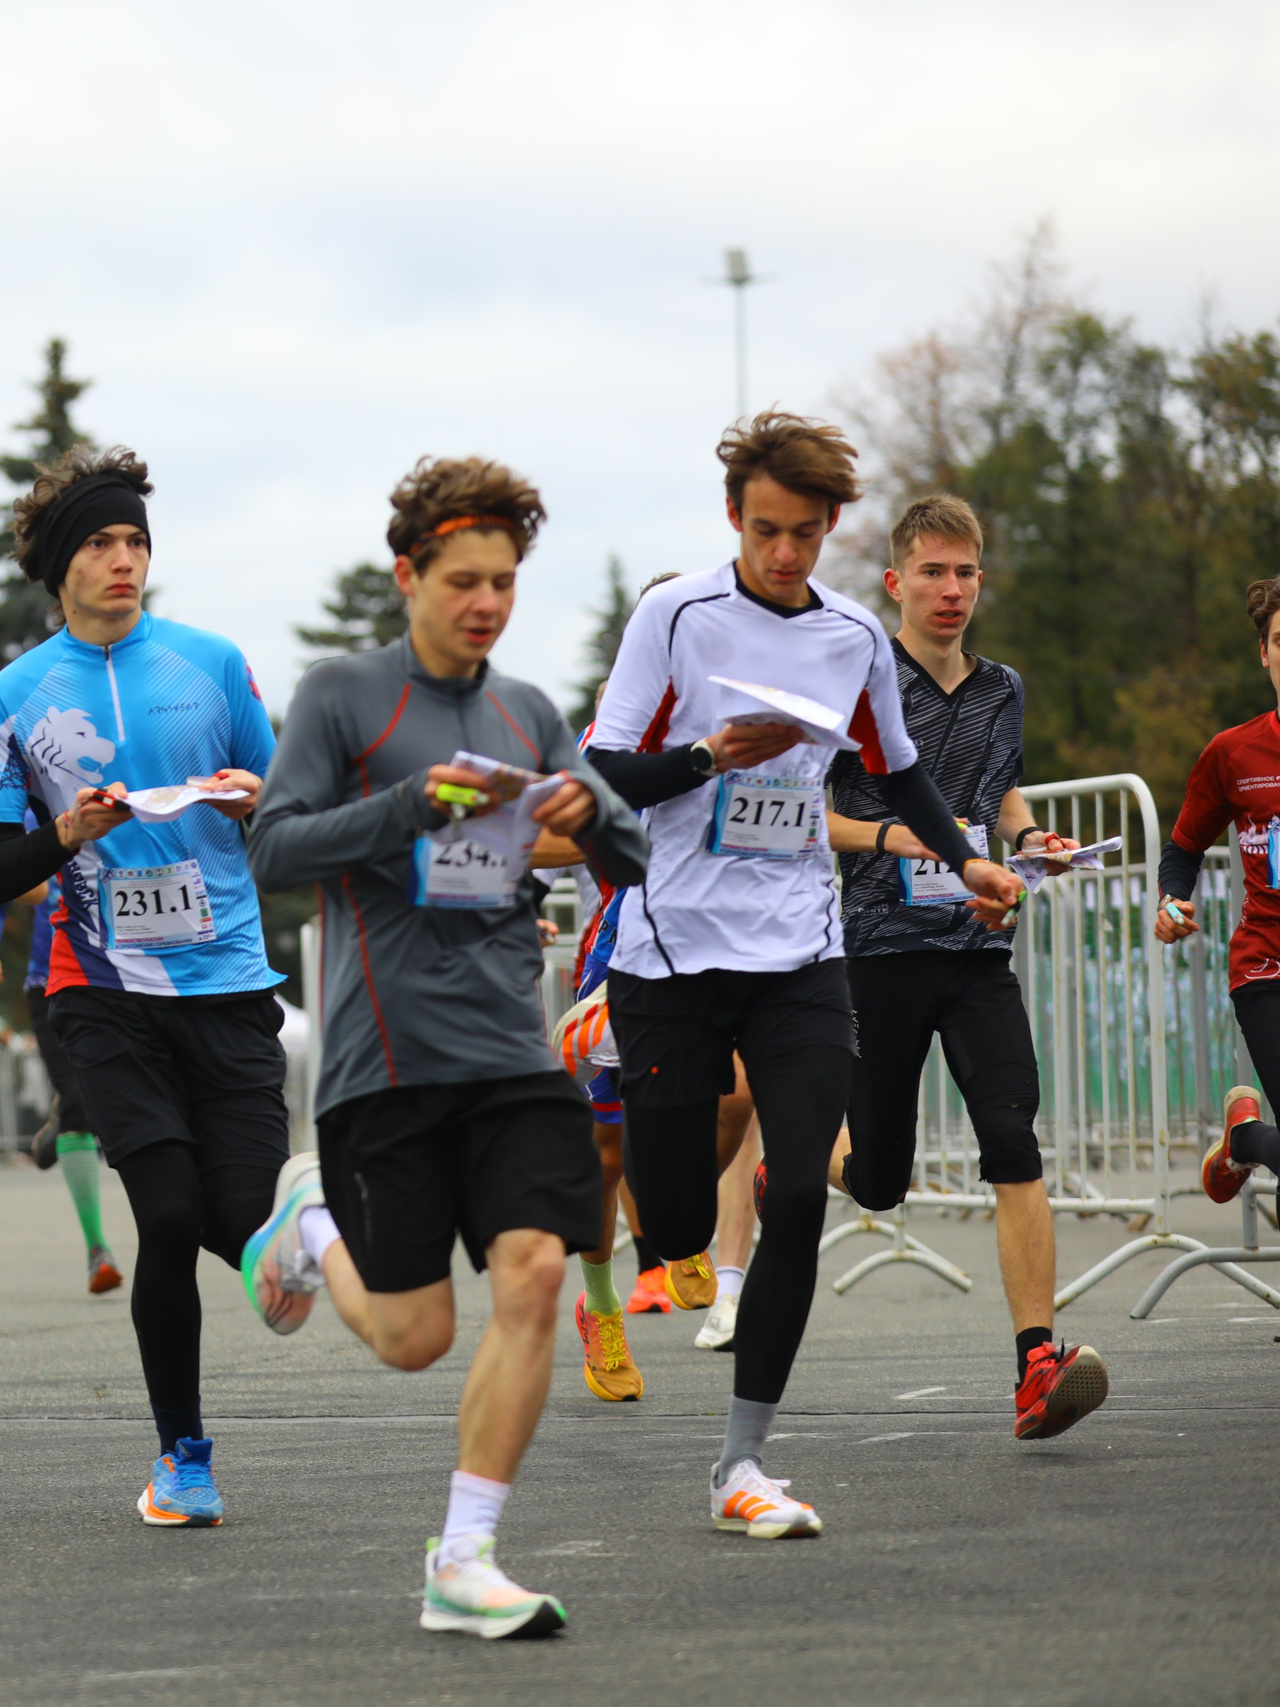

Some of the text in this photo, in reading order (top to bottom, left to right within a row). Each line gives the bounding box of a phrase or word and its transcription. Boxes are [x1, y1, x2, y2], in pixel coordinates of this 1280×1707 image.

[1236, 776, 1274, 785] СПОРТИВНОЕ
[729, 796, 805, 827] 217.1
[114, 884, 194, 917] 231.1
